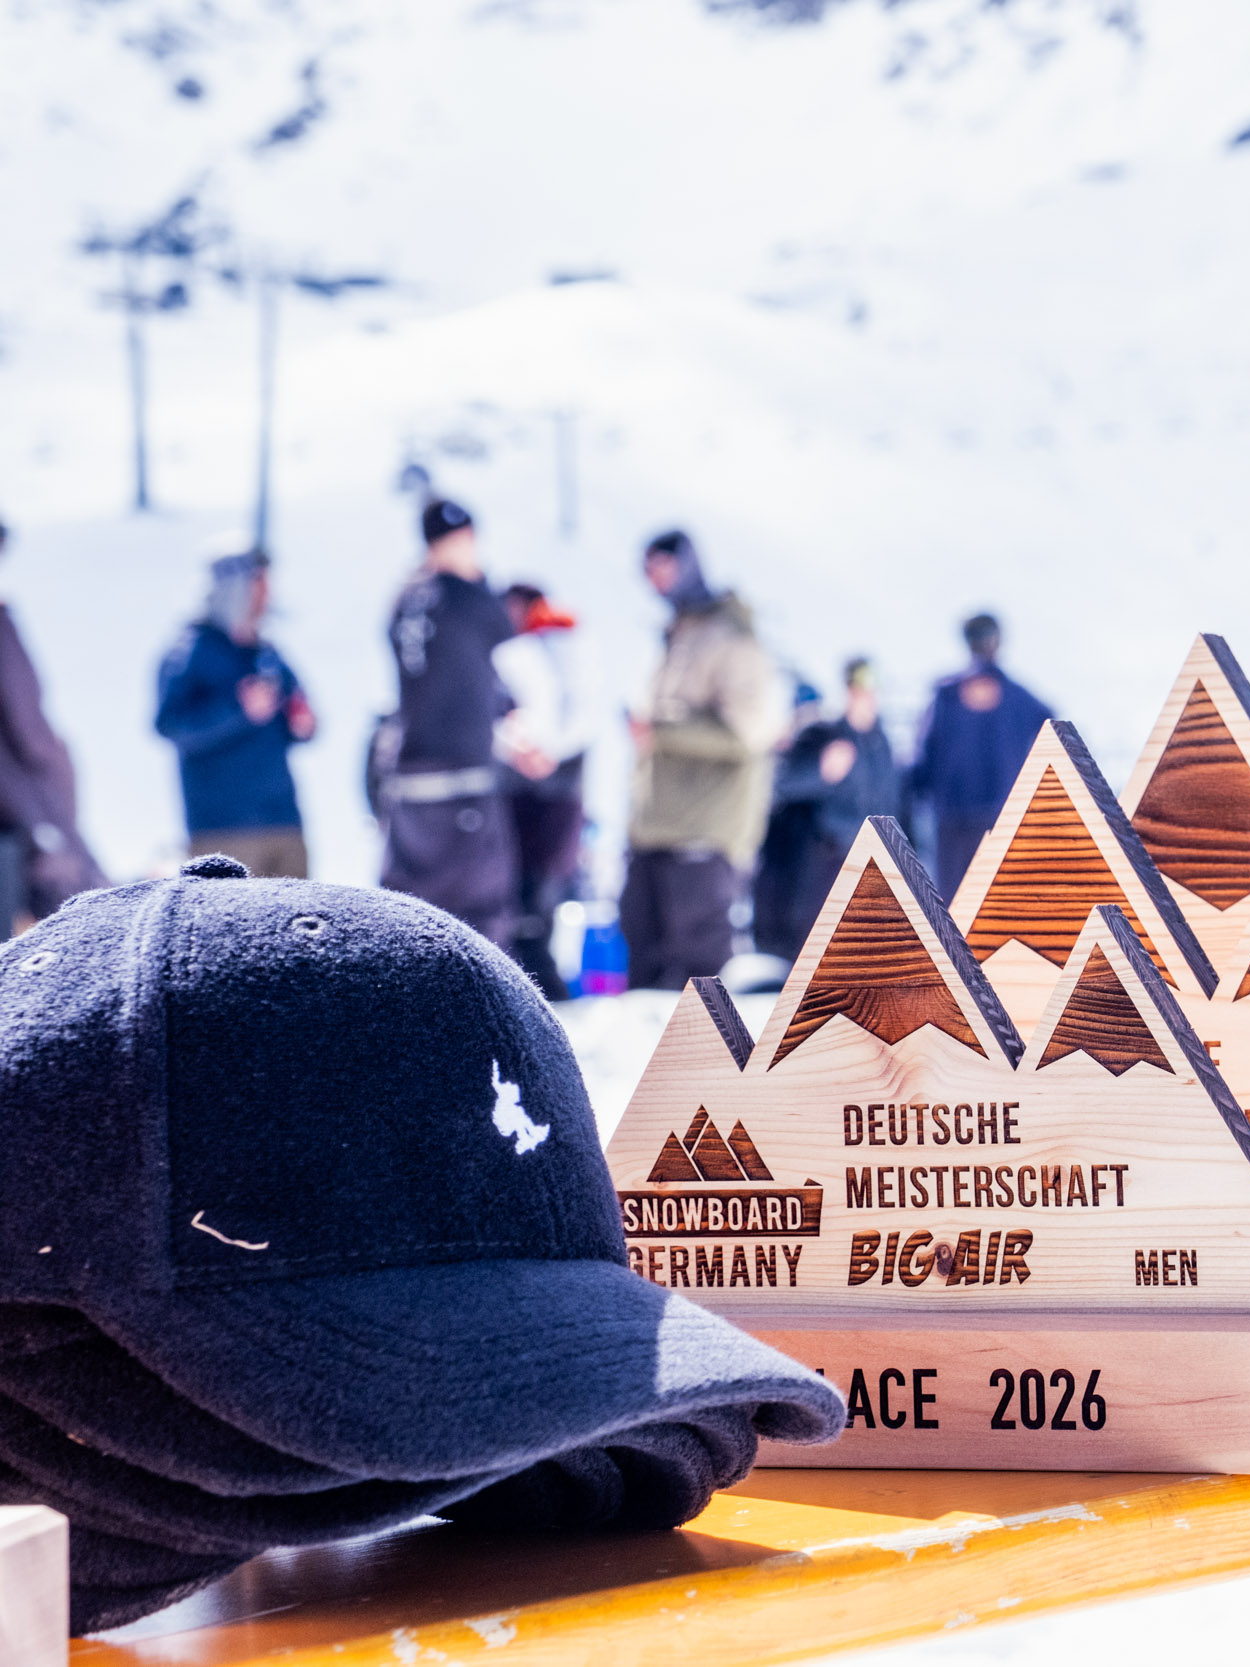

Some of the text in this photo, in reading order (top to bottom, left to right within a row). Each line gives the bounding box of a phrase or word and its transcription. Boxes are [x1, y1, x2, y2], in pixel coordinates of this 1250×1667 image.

[843, 1101, 1021, 1145] DEUTSCHE
[845, 1163, 1129, 1208] MEISTERSCHAFT
[623, 1197, 804, 1232] SNOWBOARD
[627, 1244, 803, 1287] GERMANY
[847, 1228, 1034, 1287] BIG AIR
[1135, 1249, 1198, 1286] MEN
[815, 1368, 1107, 1430] ACE 2026
